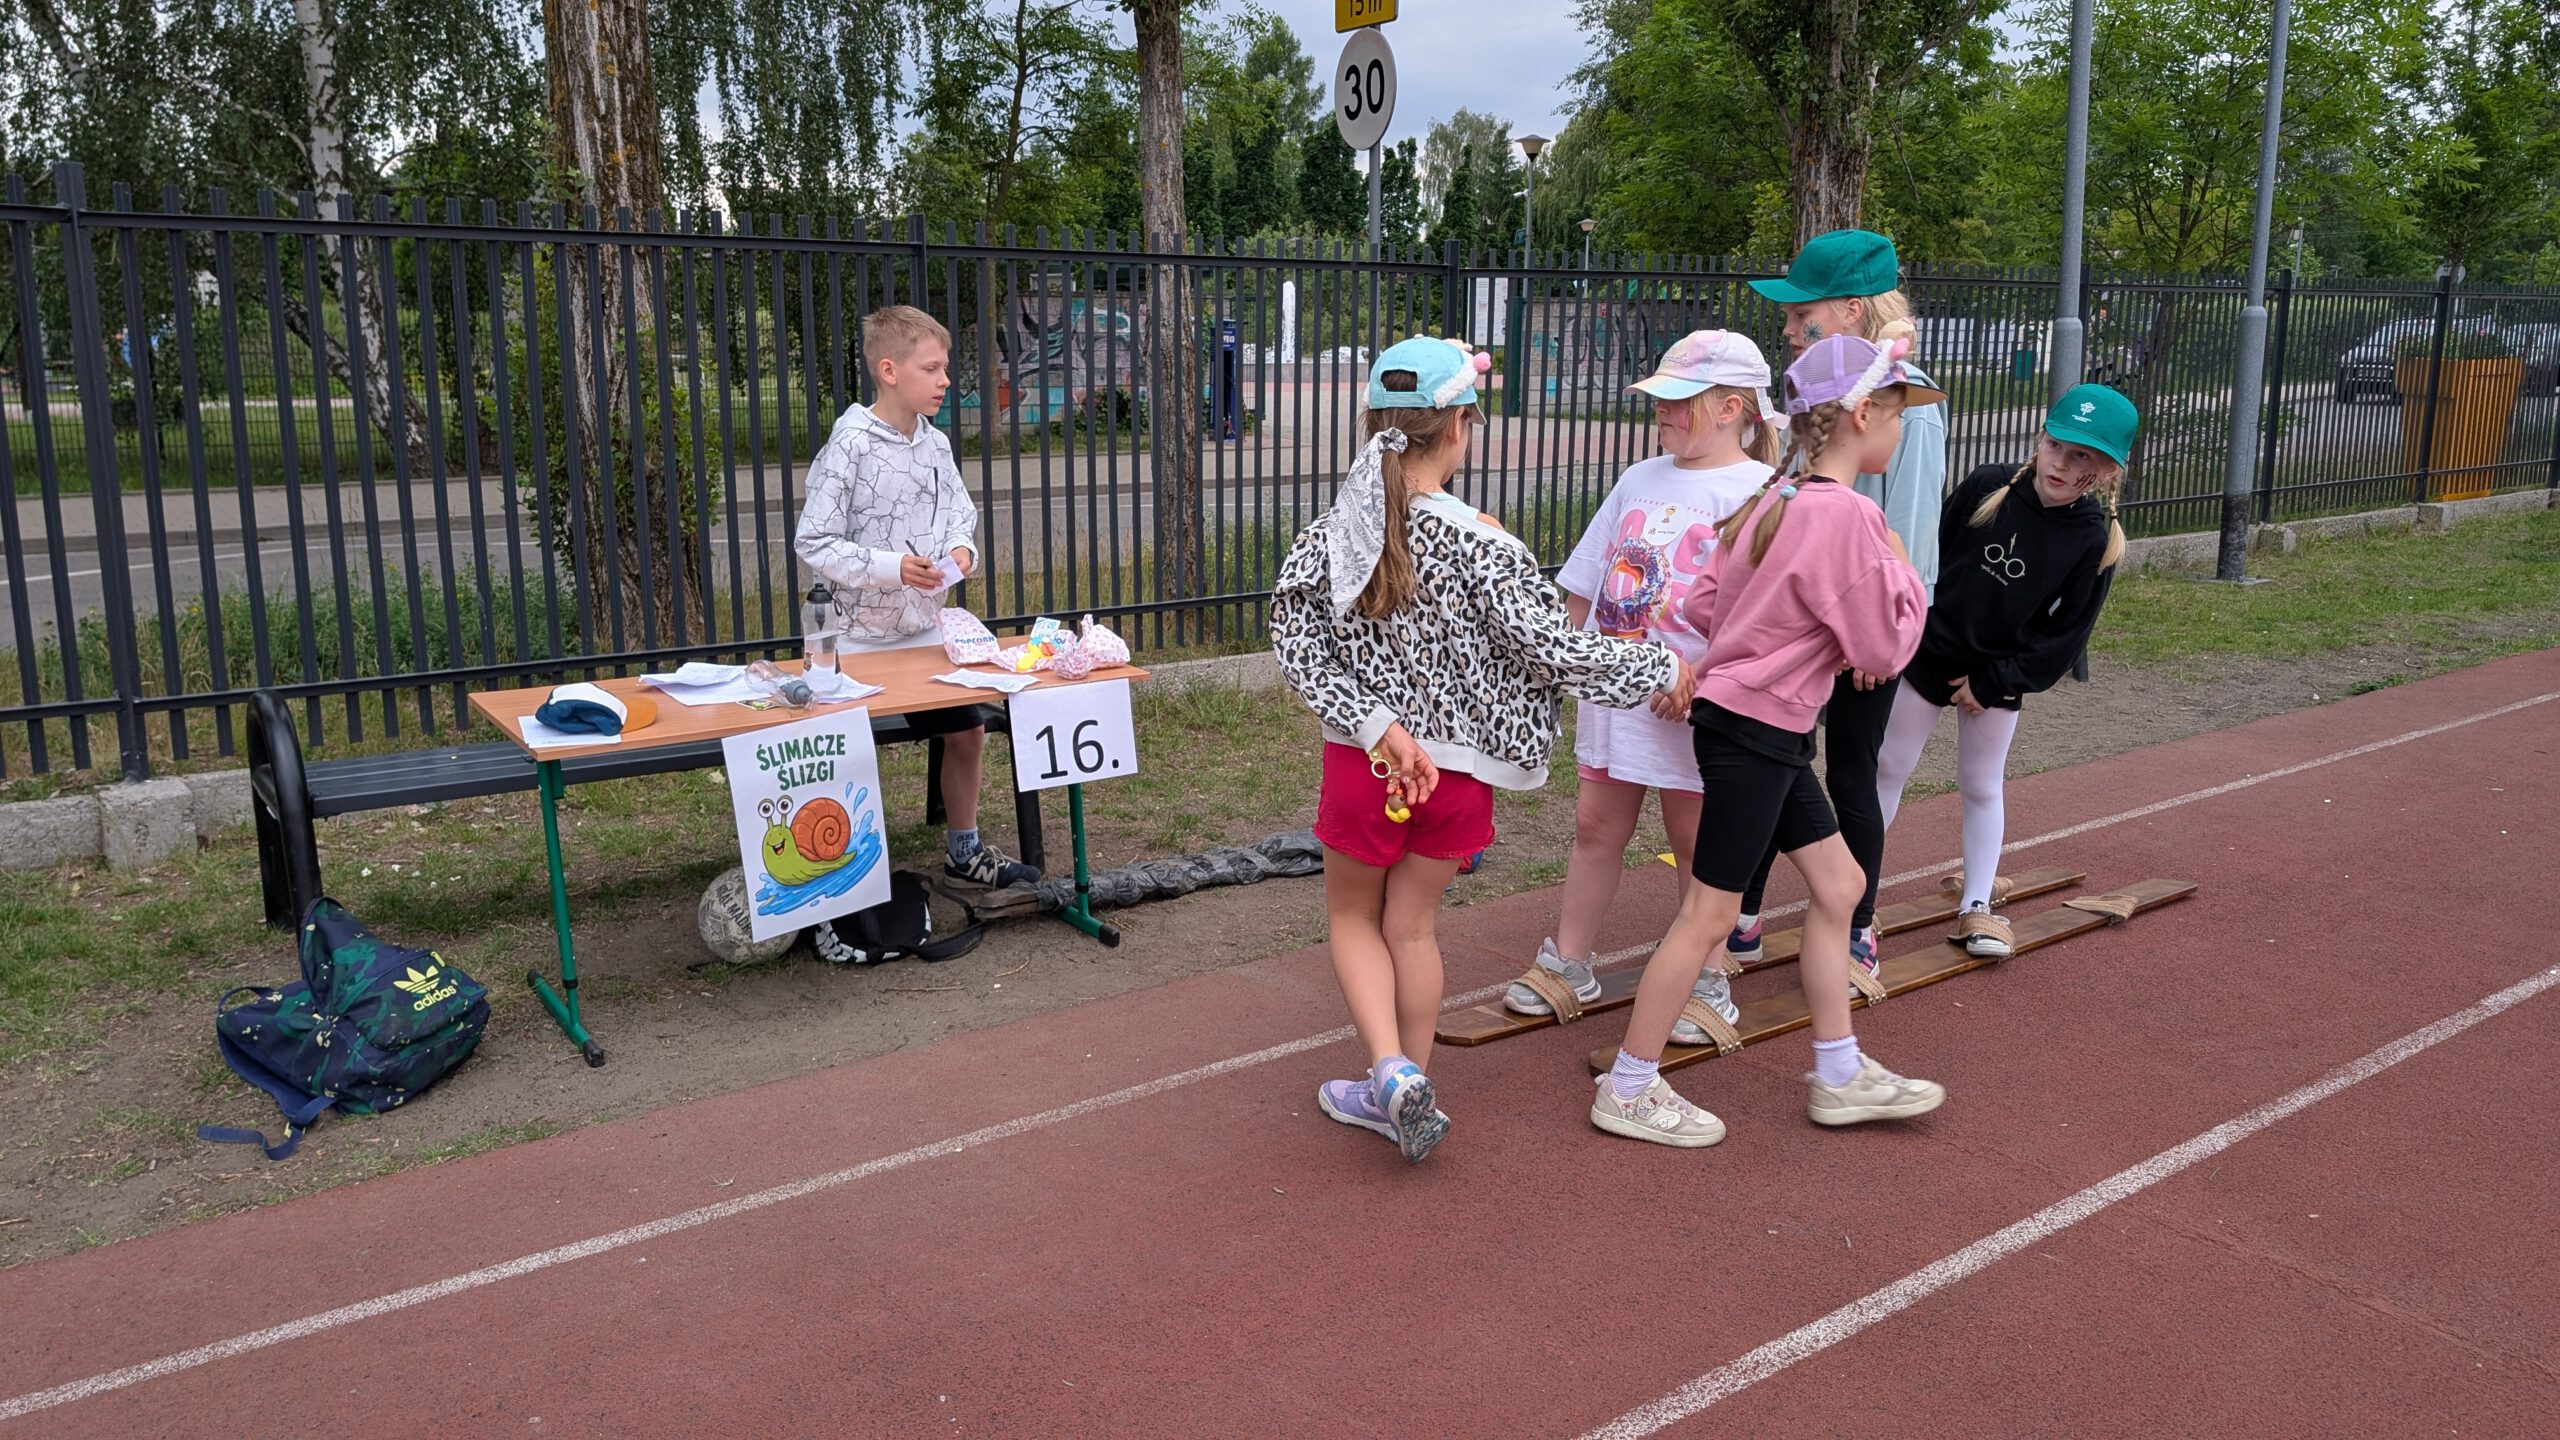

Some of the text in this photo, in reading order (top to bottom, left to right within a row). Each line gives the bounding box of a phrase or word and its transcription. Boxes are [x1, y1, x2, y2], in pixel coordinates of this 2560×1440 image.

[1344, 58, 1385, 121] 30
[955, 636, 995, 645] POPCORN
[756, 734, 846, 771] ŚLIMACZE
[1035, 719, 1120, 780] 16.
[777, 760, 835, 791] ŚLIZGI
[716, 884, 752, 931] REAL MADR
[413, 985, 457, 1011] adidas
